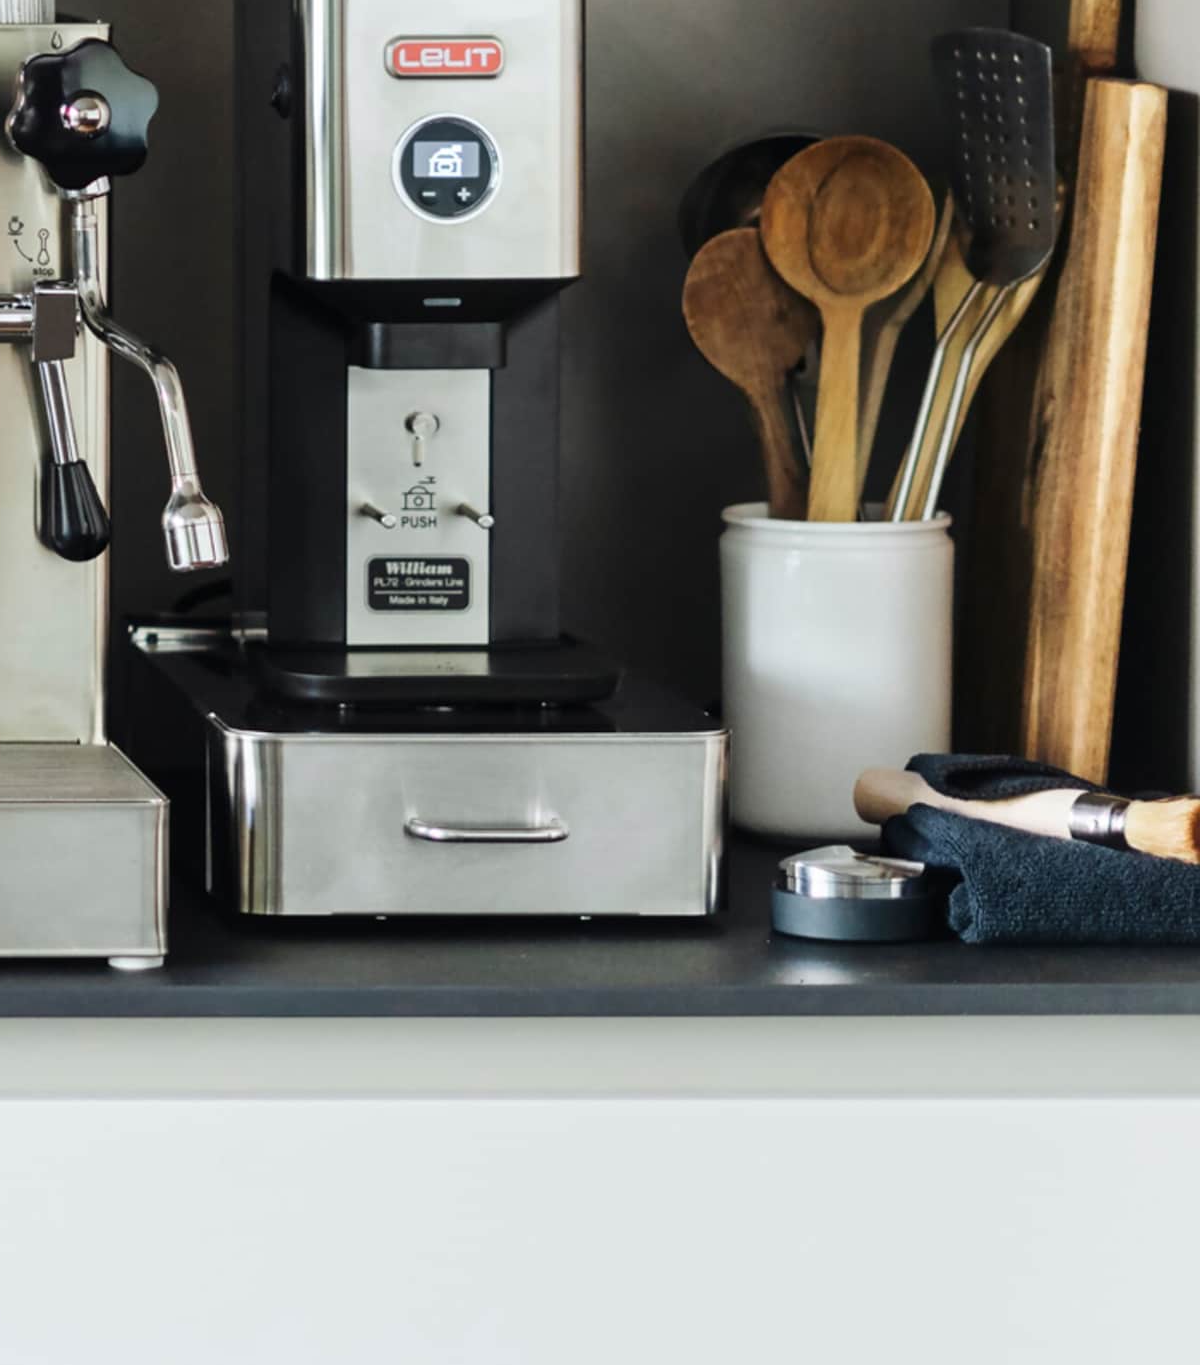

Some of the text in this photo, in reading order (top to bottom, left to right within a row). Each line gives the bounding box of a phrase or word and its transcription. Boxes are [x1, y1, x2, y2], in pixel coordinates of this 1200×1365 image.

[32, 267, 55, 276] stop
[401, 516, 438, 529] PUSH
[385, 561, 453, 575] William
[373, 577, 464, 587] PL72 Grinders Line
[388, 596, 449, 608] Made in Italy
